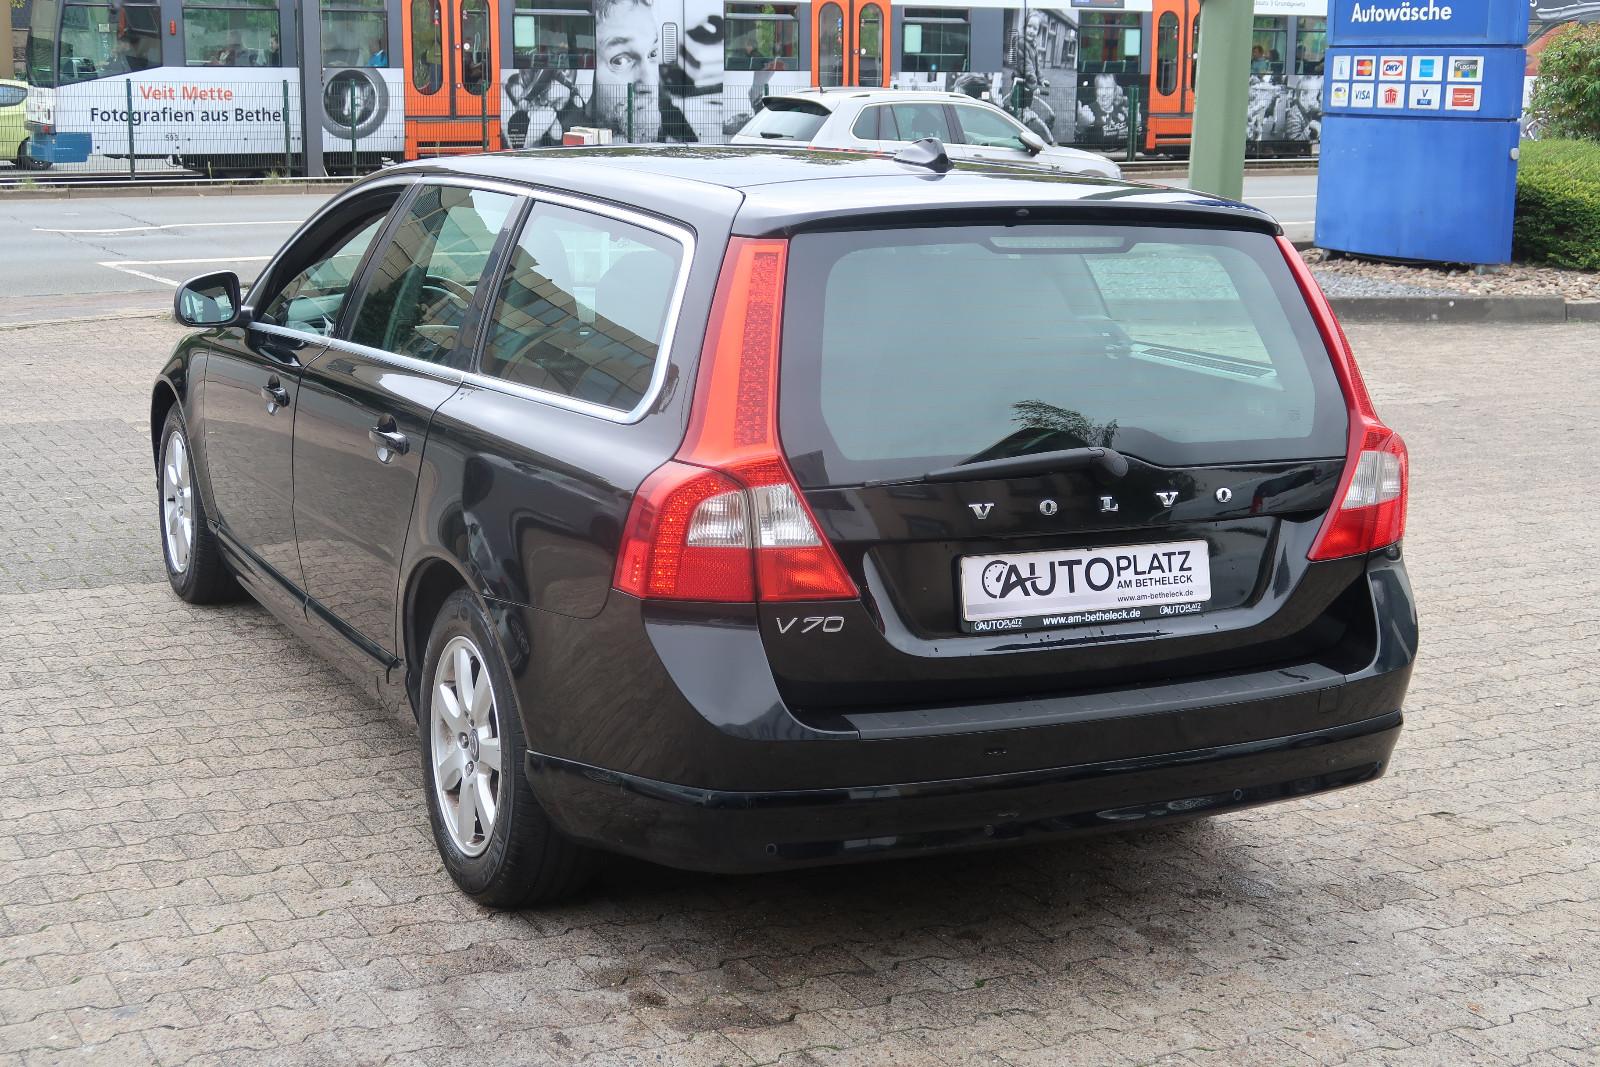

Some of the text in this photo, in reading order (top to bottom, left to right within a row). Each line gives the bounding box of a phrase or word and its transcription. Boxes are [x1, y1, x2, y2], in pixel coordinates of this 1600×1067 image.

[1351, 0, 1452, 23] Autowäsche
[1385, 64, 1401, 72] DKV
[140, 85, 233, 101] Veit Mette
[1355, 89, 1371, 100] VISA
[90, 107, 195, 126] Fotografien
[201, 112, 229, 122] aus
[165, 134, 179, 142] 593
[968, 487, 1233, 520] VOLVO
[1117, 574, 1194, 590] AM BETHELECK
[1117, 589, 1195, 602] www.am-betheleck.de
[1042, 608, 1141, 626] www.am-betheleck.de
